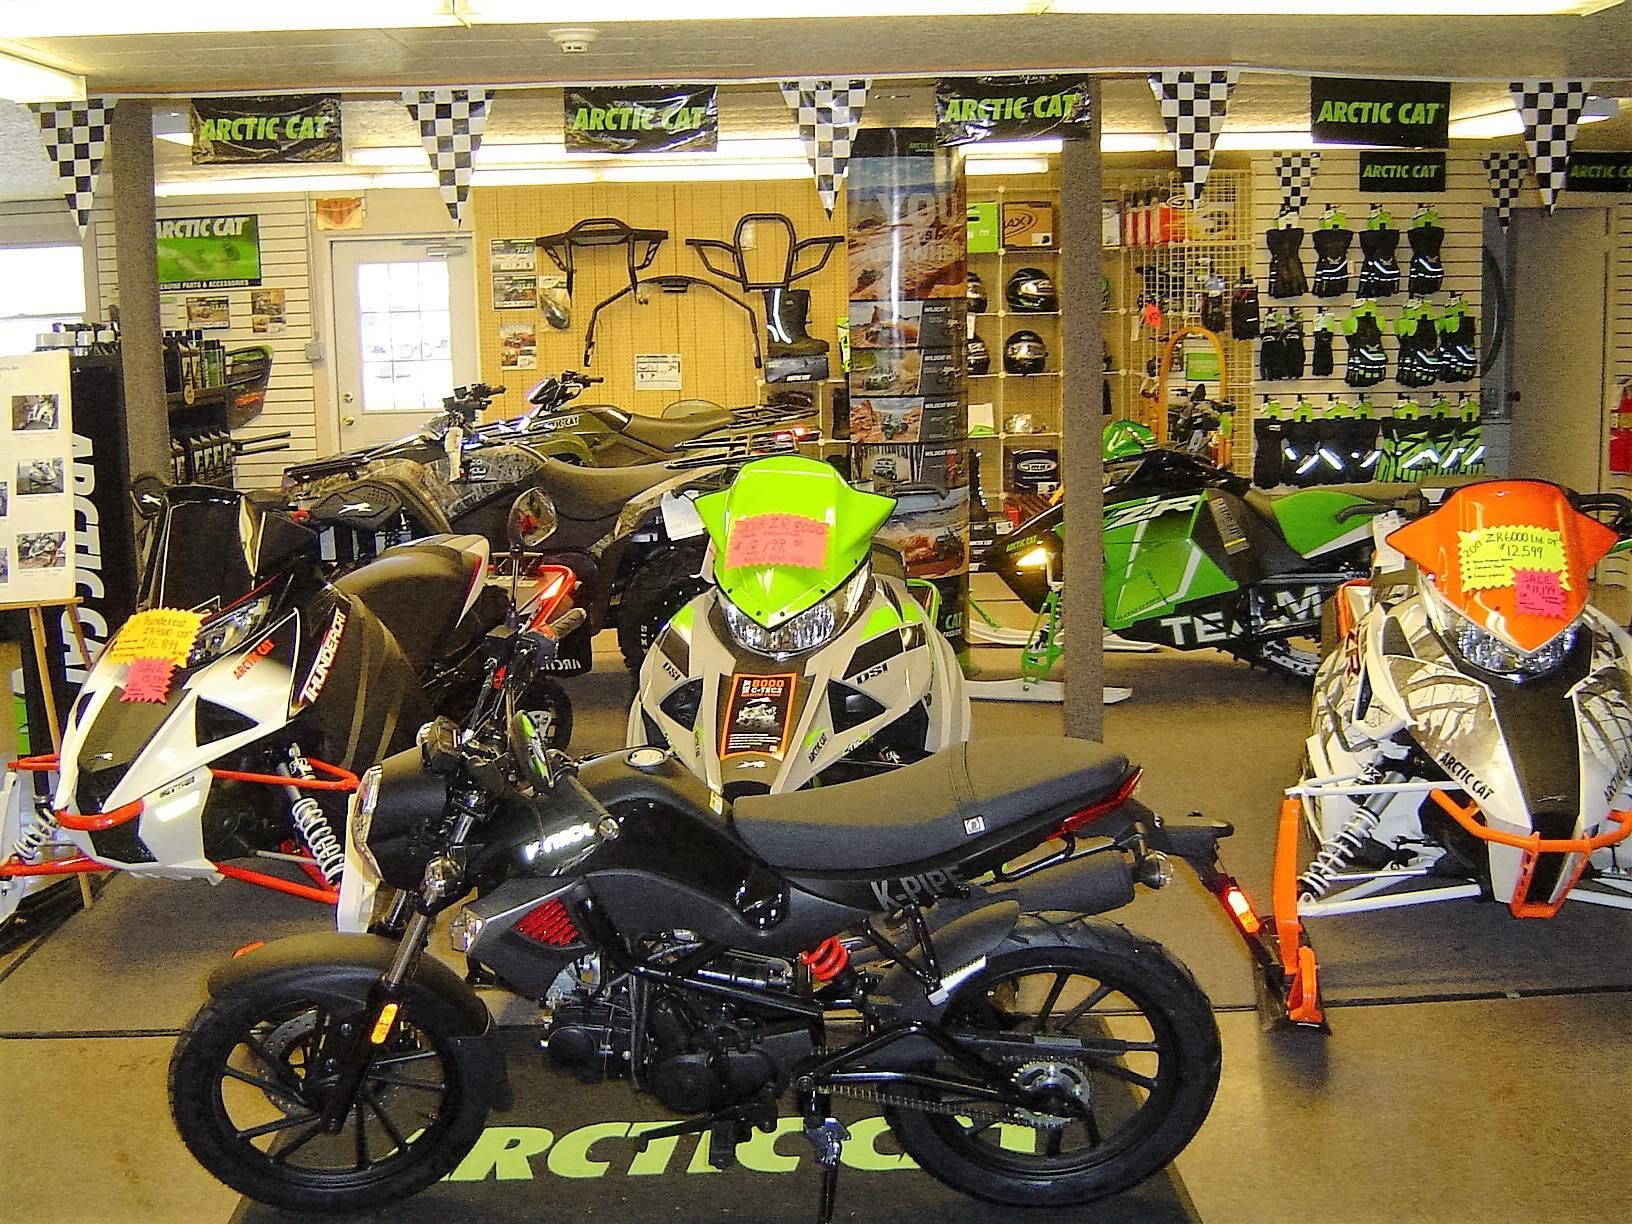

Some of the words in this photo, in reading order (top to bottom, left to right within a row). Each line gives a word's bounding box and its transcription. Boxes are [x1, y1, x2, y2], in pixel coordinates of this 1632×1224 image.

[572, 107, 656, 130] ARCTIC
[661, 107, 706, 130] CAT
[943, 97, 1028, 122] ARCTIC
[1033, 93, 1081, 122] CAT
[1316, 101, 1393, 124] ARCTIC
[1398, 103, 1440, 124] CAT
[202, 116, 280, 141] ARCTIC
[286, 115, 330, 140] CAT
[1362, 165, 1411, 178] ARCTIC
[1412, 165, 1438, 178] CAT
[1570, 165, 1617, 178] ARCTIC
[213, 217, 249, 237] CAT
[1523, 574, 1552, 585] SALE
[233, 651, 264, 680] ARCTIC
[304, 606, 347, 703] THUNDERCAT
[751, 680, 785, 688] 8000
[1439, 752, 1475, 787] ARCTIC
[1472, 779, 1495, 801] CAT
